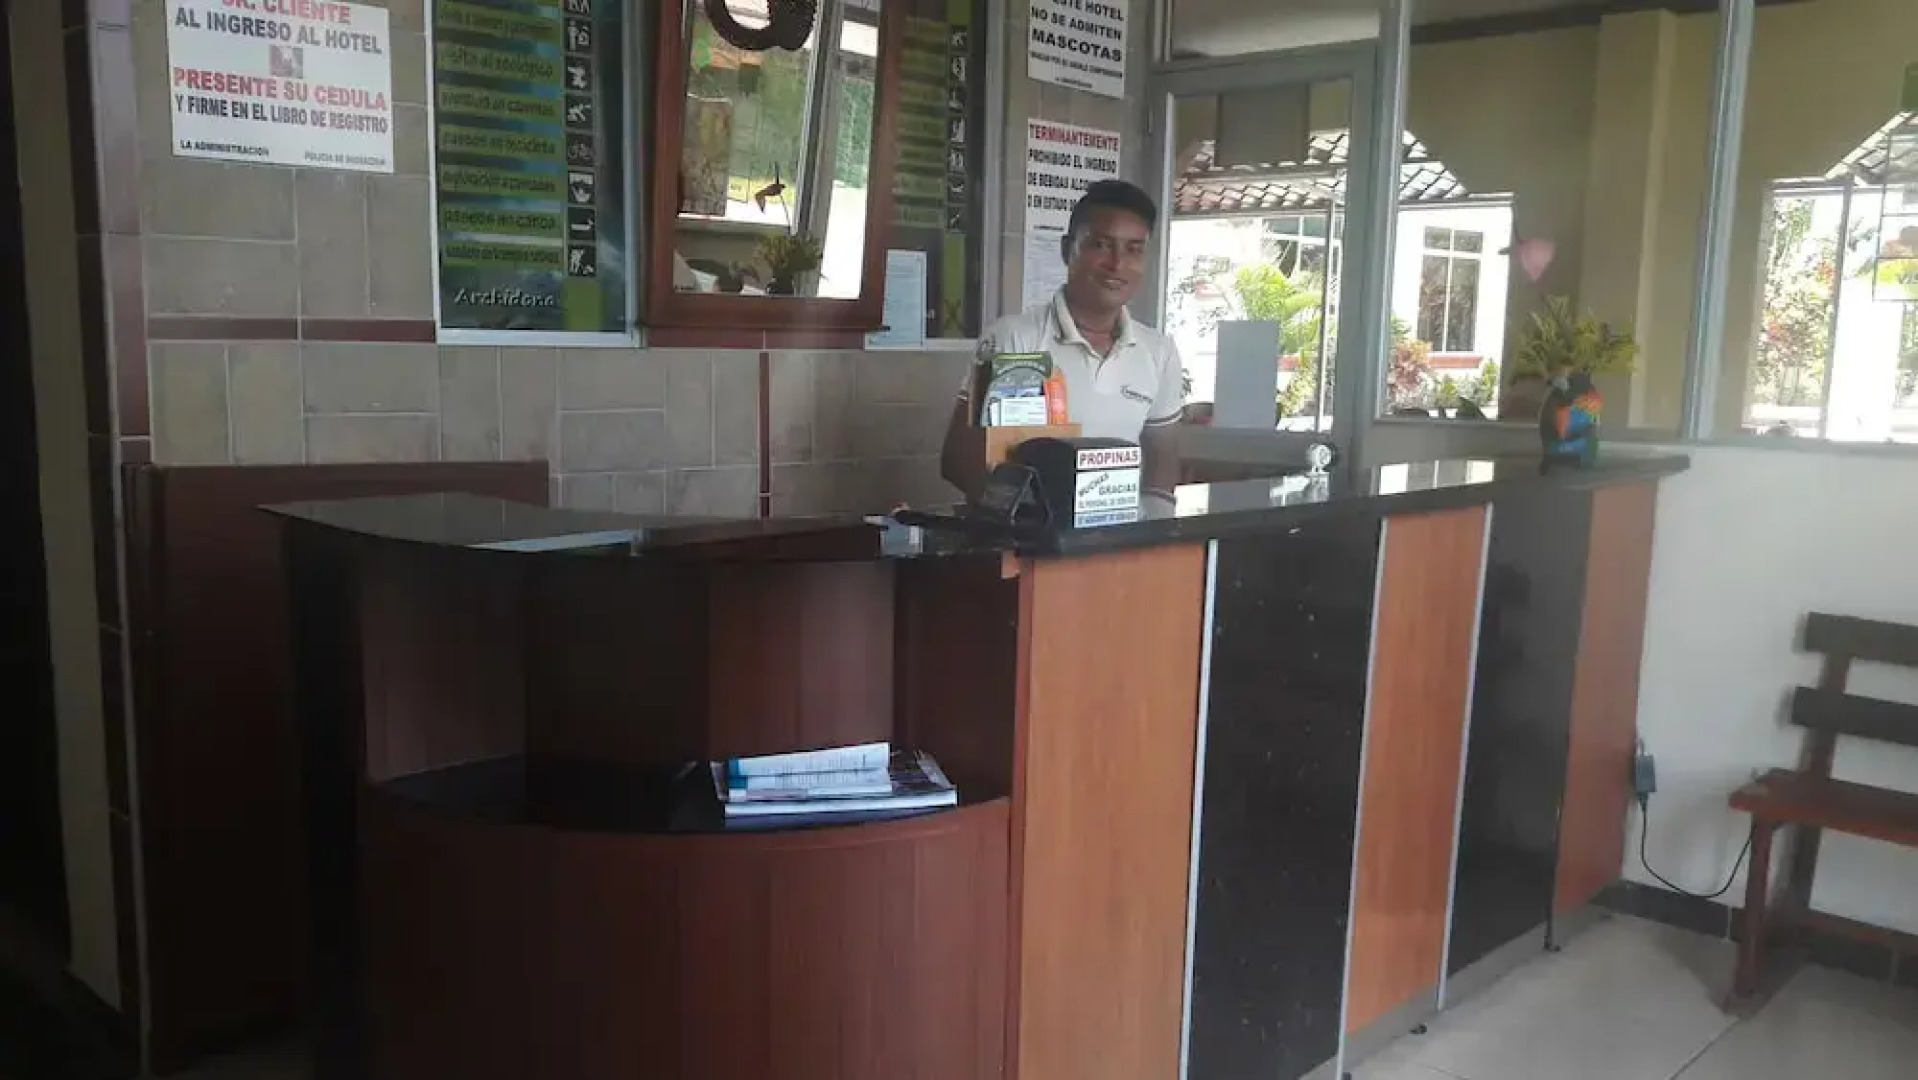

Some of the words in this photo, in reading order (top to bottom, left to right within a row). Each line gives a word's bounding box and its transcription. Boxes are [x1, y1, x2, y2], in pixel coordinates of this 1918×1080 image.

[263, 0, 351, 24] CLIENTE
[1031, 6, 1048, 20] NO
[1051, 13, 1066, 26] SE
[1069, 17, 1122, 40] ADMITEN
[1085, 1, 1124, 21] HOTEL
[175, 7, 200, 29] AL
[207, 11, 291, 41] INGRESO
[297, 25, 320, 46] AL
[326, 29, 383, 54] HOTEL
[1032, 28, 1121, 62] MASCOTAS
[174, 67, 277, 99] PRESENTE
[283, 81, 308, 102] SU
[314, 85, 388, 110] CEDULA
[175, 94, 185, 113] Y
[187, 95, 228, 117] FIRME
[231, 101, 249, 119] EN
[252, 103, 267, 121] EL
[271, 105, 306, 125] LIBRO
[310, 110, 327, 127] DE
[330, 112, 388, 133] REGISTRO
[180, 140, 192, 149] LA
[1029, 123, 1118, 152] TERMINANTEMENTE
[1073, 155, 1082, 169] EL
[1080, 450, 1138, 466] PROPINAS
[1078, 472, 1109, 497] MUCHAS
[1099, 483, 1136, 495] GRACIAS
